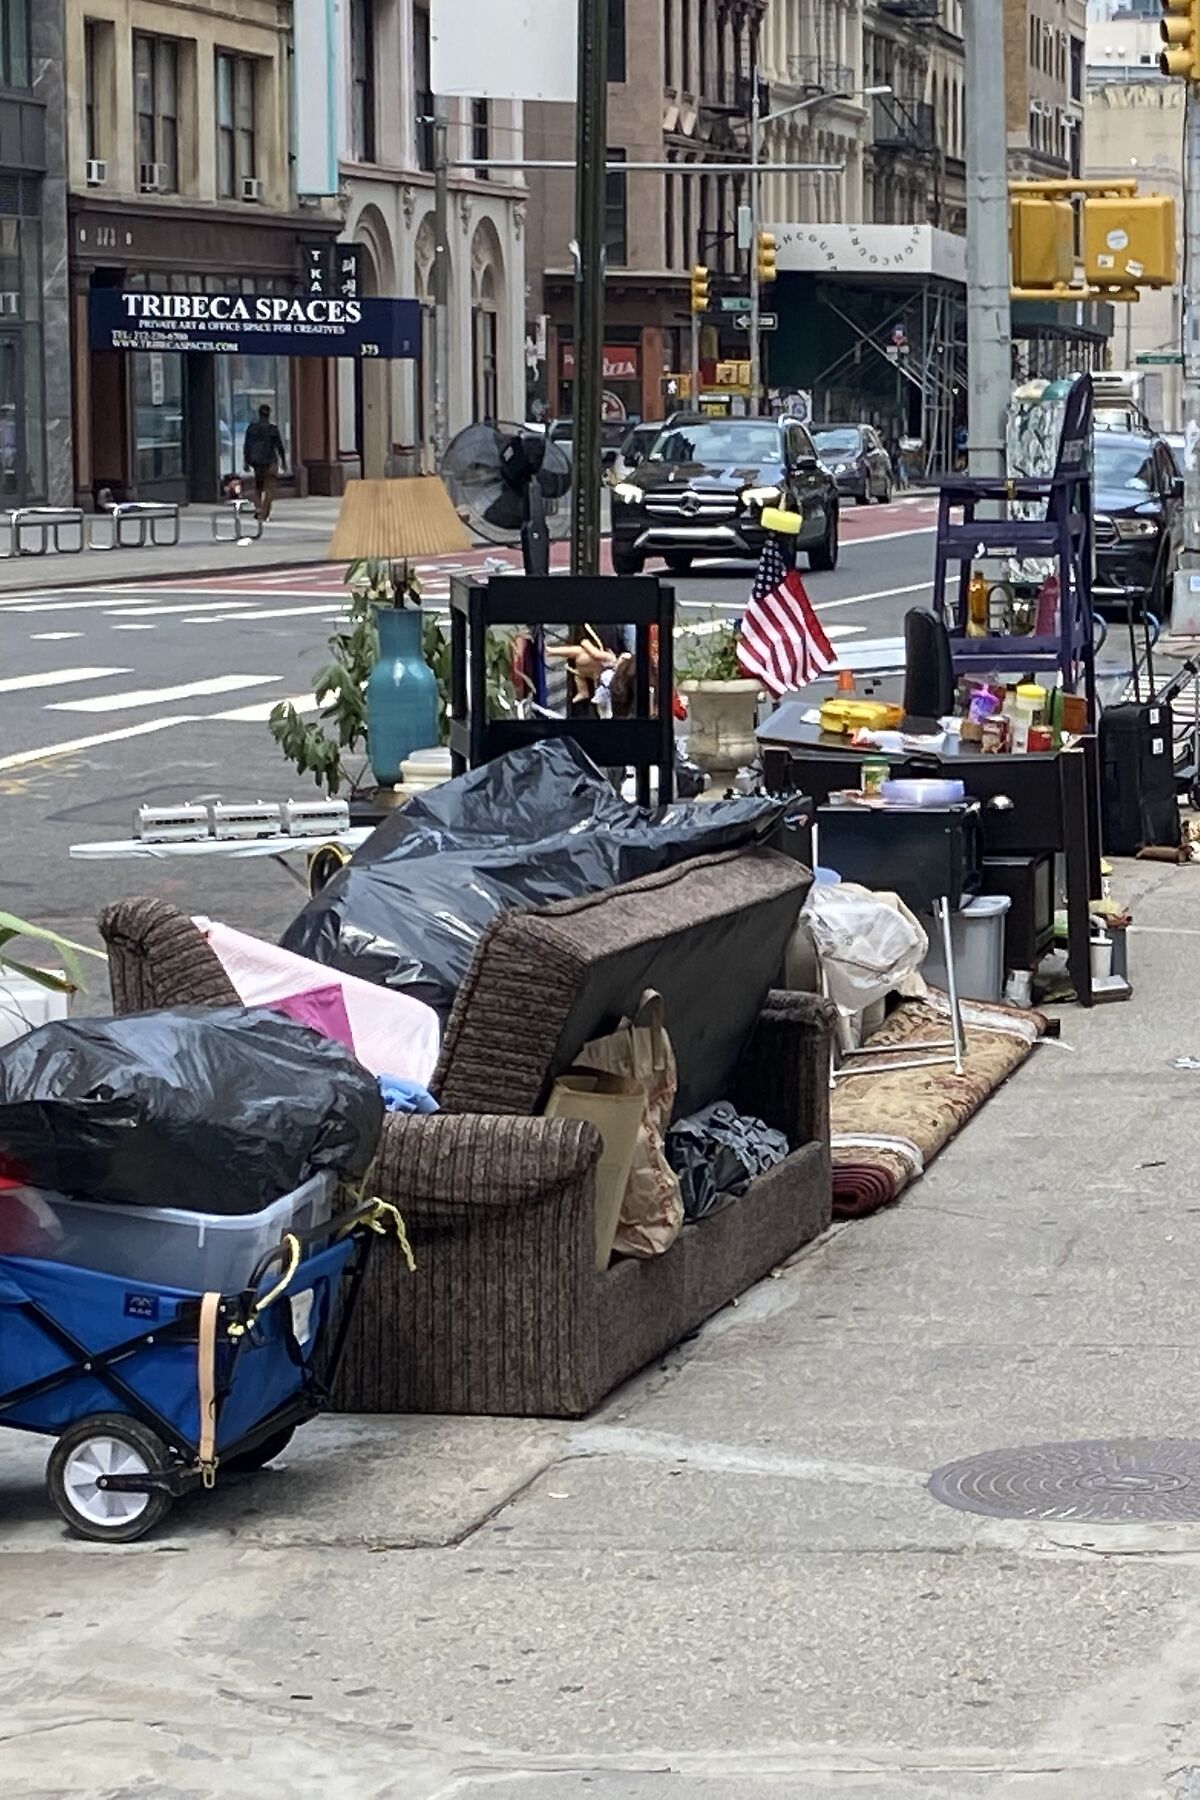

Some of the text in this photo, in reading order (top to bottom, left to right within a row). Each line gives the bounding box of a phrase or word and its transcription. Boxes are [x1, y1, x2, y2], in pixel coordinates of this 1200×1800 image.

[121, 293, 362, 323] TRIBECA SPACES
[138, 319, 177, 330] PRIVATE
[208, 321, 240, 331] OFFICE
[243, 322, 271, 332] SPACE
[273, 323, 292, 333] FOR
[294, 324, 345, 335] CREATIVES
[360, 343, 379, 356] 373
